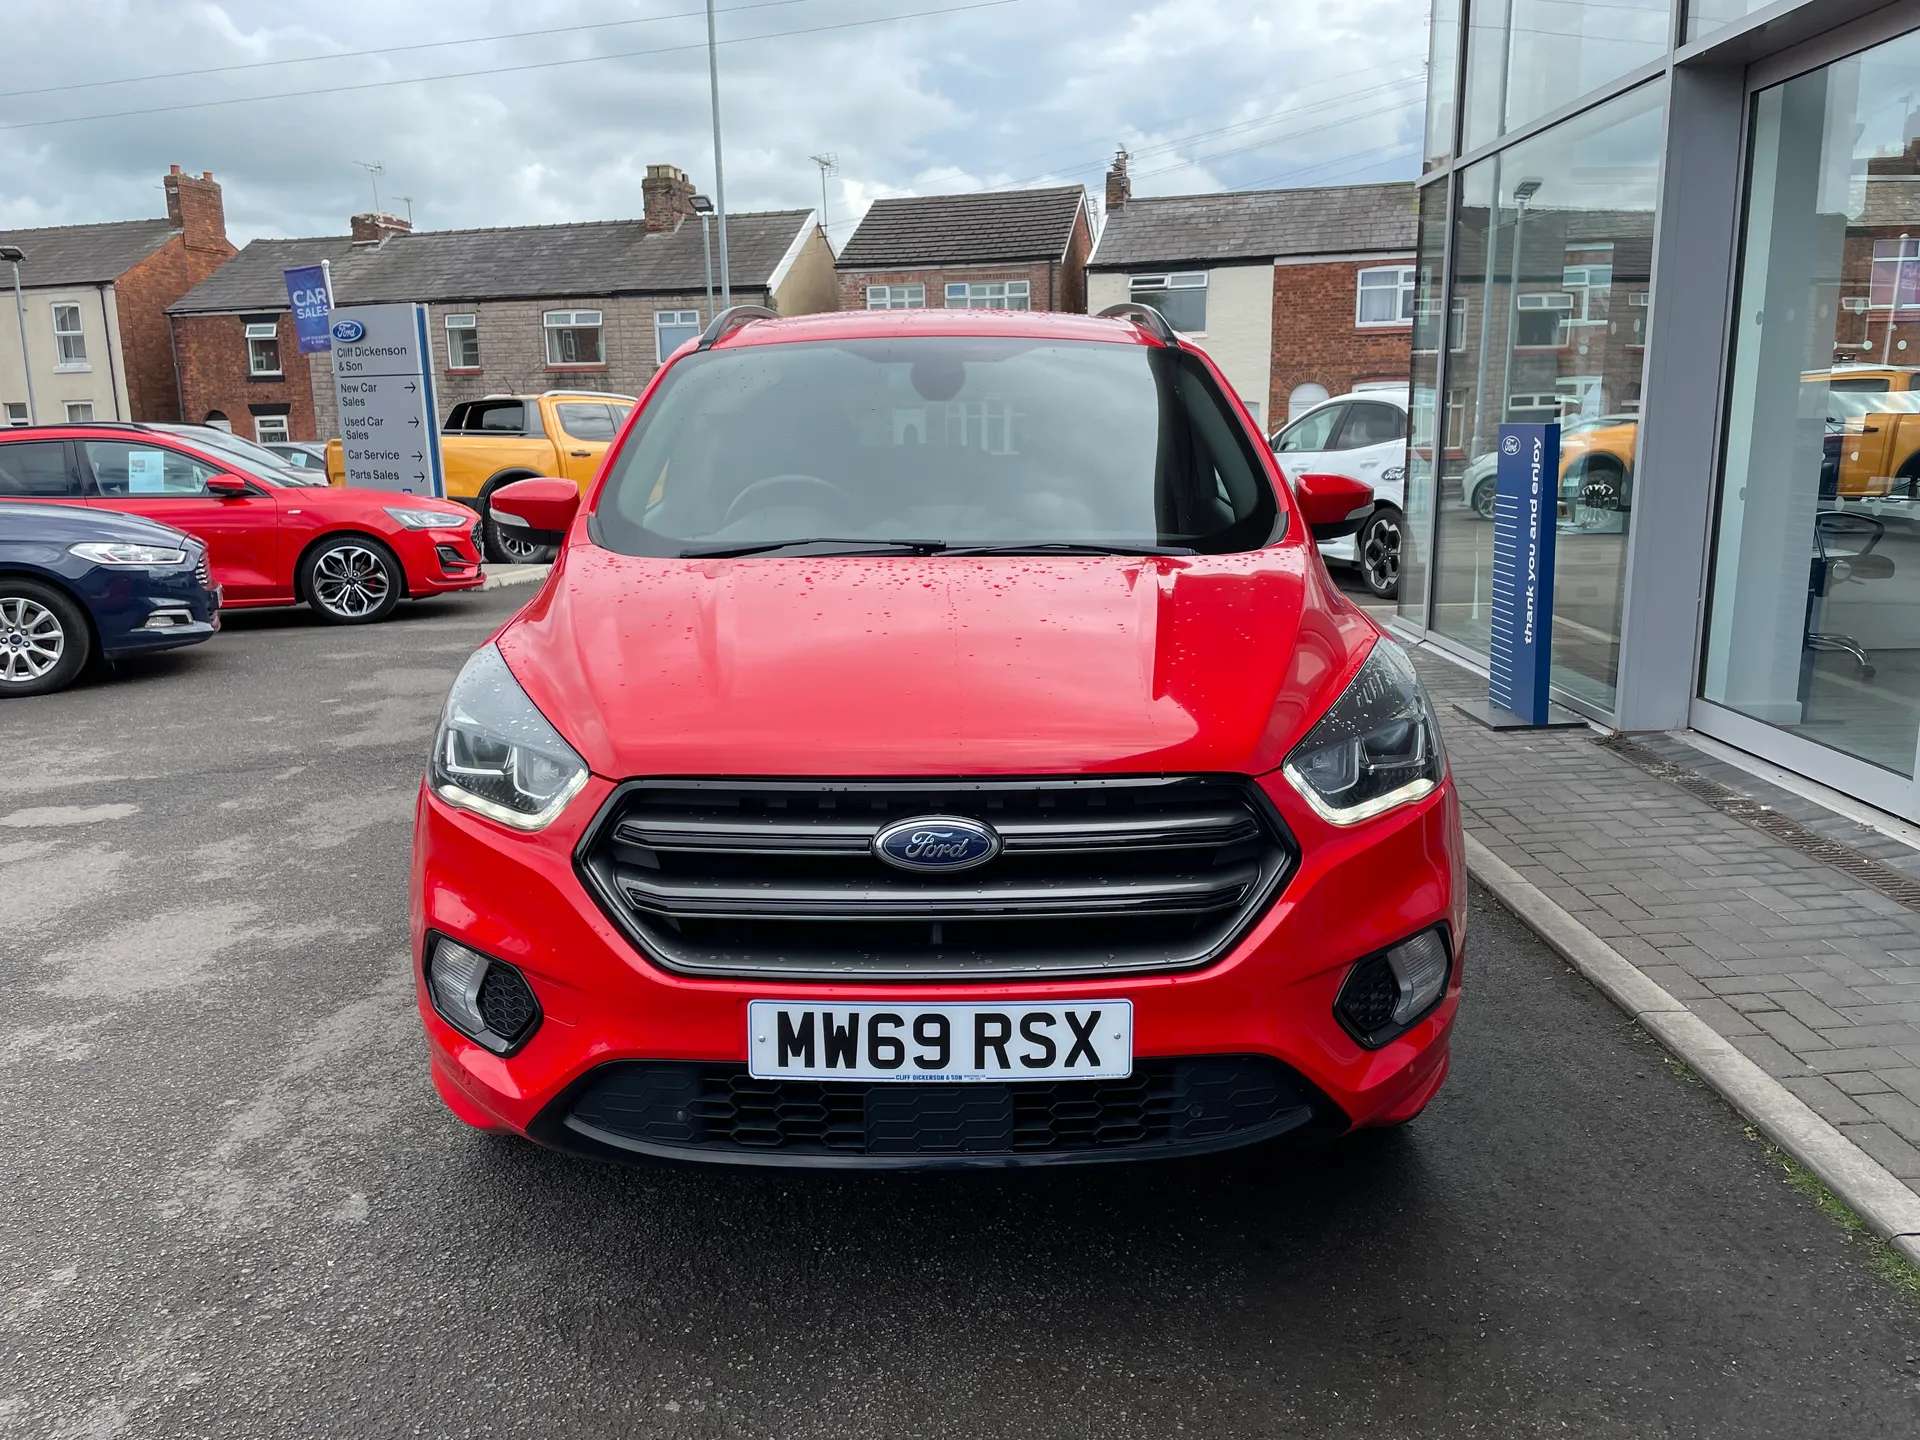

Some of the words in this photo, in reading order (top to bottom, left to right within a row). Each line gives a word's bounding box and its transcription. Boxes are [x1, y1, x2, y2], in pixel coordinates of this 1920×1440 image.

[292, 287, 327, 306] CAR
[296, 305, 329, 319] SALES
[337, 323, 356, 337] Ford
[337, 346, 353, 358] Cliff
[355, 345, 407, 357] Dickenson
[338, 361, 345, 371] &
[346, 361, 363, 371] Son
[341, 383, 359, 393] New
[360, 382, 377, 393] Car
[342, 396, 366, 407] Sales
[344, 417, 365, 427] Used
[367, 416, 384, 427] Car
[346, 430, 369, 440] Sales
[348, 449, 363, 460] Car
[364, 449, 400, 460] Service
[1531, 436, 1542, 495] enjoy
[350, 469, 371, 480] Parts
[373, 469, 400, 480] Sales
[1529, 499, 1538, 540] and
[1527, 543, 1536, 581] you
[1524, 584, 1534, 644] thank
[905, 831, 969, 858] Ford
[776, 1010, 951, 1070] MW69
[974, 1010, 1102, 1069] RSX
